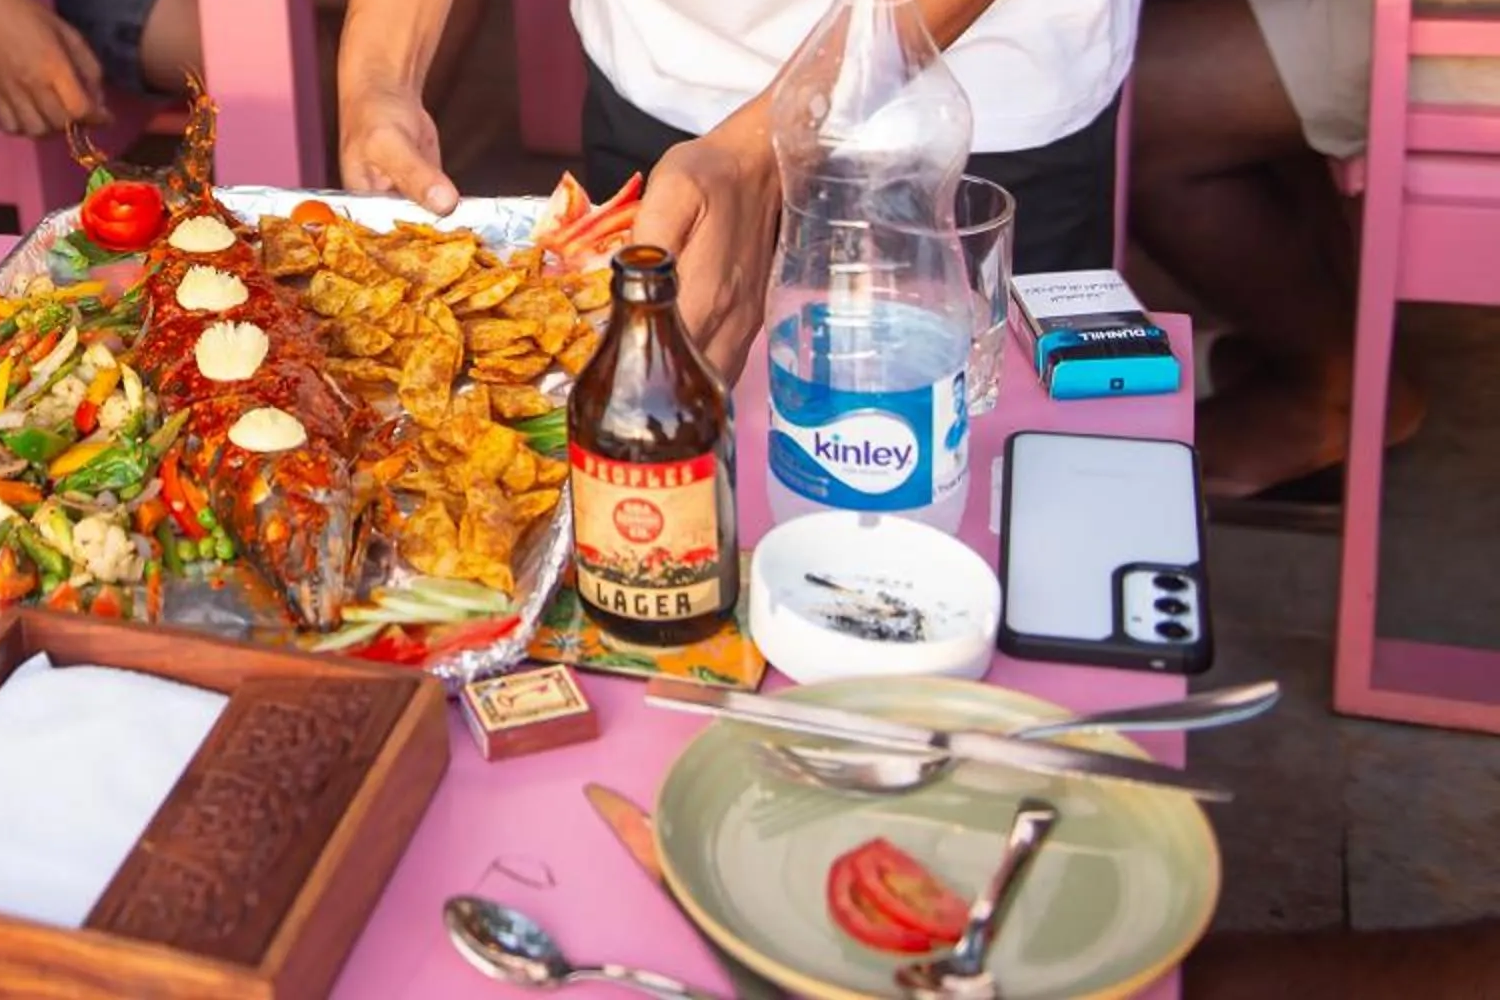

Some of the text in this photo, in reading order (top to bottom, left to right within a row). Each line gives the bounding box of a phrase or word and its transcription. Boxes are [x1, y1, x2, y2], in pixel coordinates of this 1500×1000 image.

[1078, 328, 1147, 342] DUNHILL
[815, 432, 912, 470] kinley
[584, 456, 693, 487] PEOPLES
[596, 582, 692, 616] LAGER
